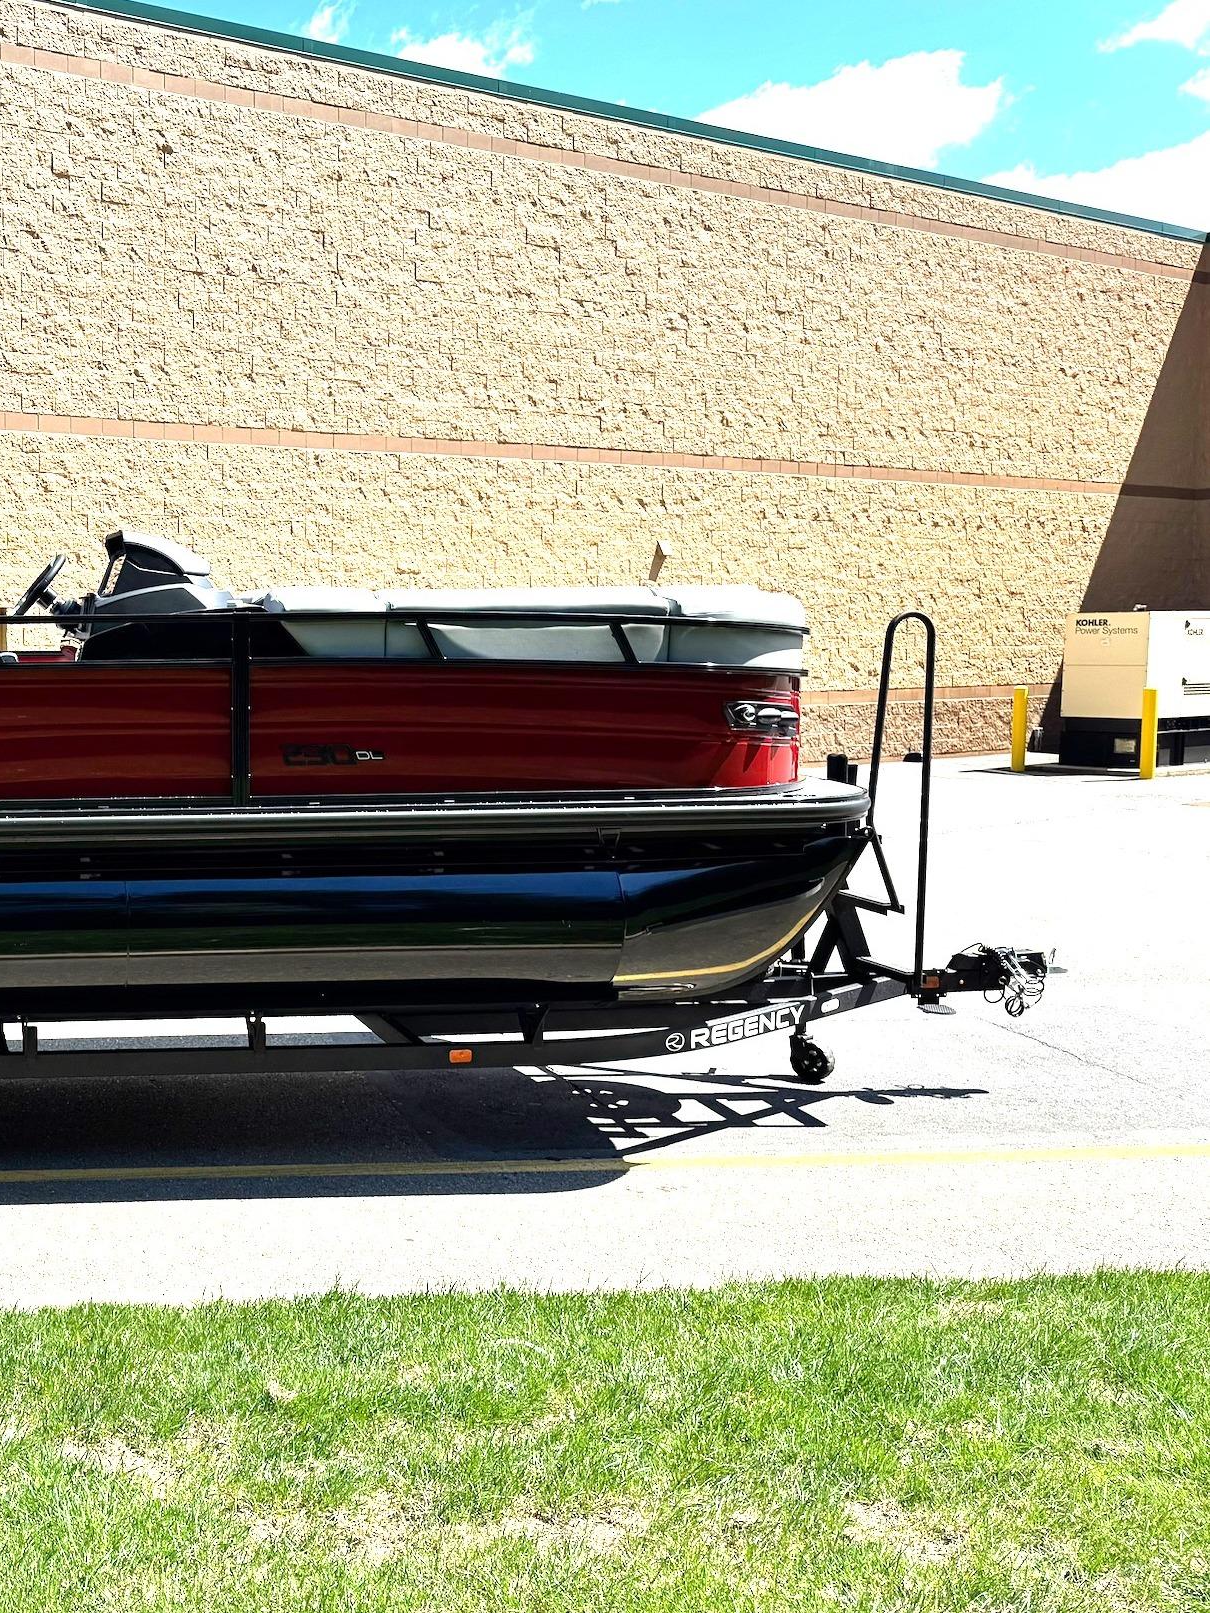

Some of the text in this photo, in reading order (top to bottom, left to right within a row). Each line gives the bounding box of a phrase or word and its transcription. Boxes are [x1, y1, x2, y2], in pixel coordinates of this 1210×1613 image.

[1075, 627, 1139, 636] Power Systems
[356, 751, 384, 760] DL
[690, 1004, 805, 1049] REGENCY
